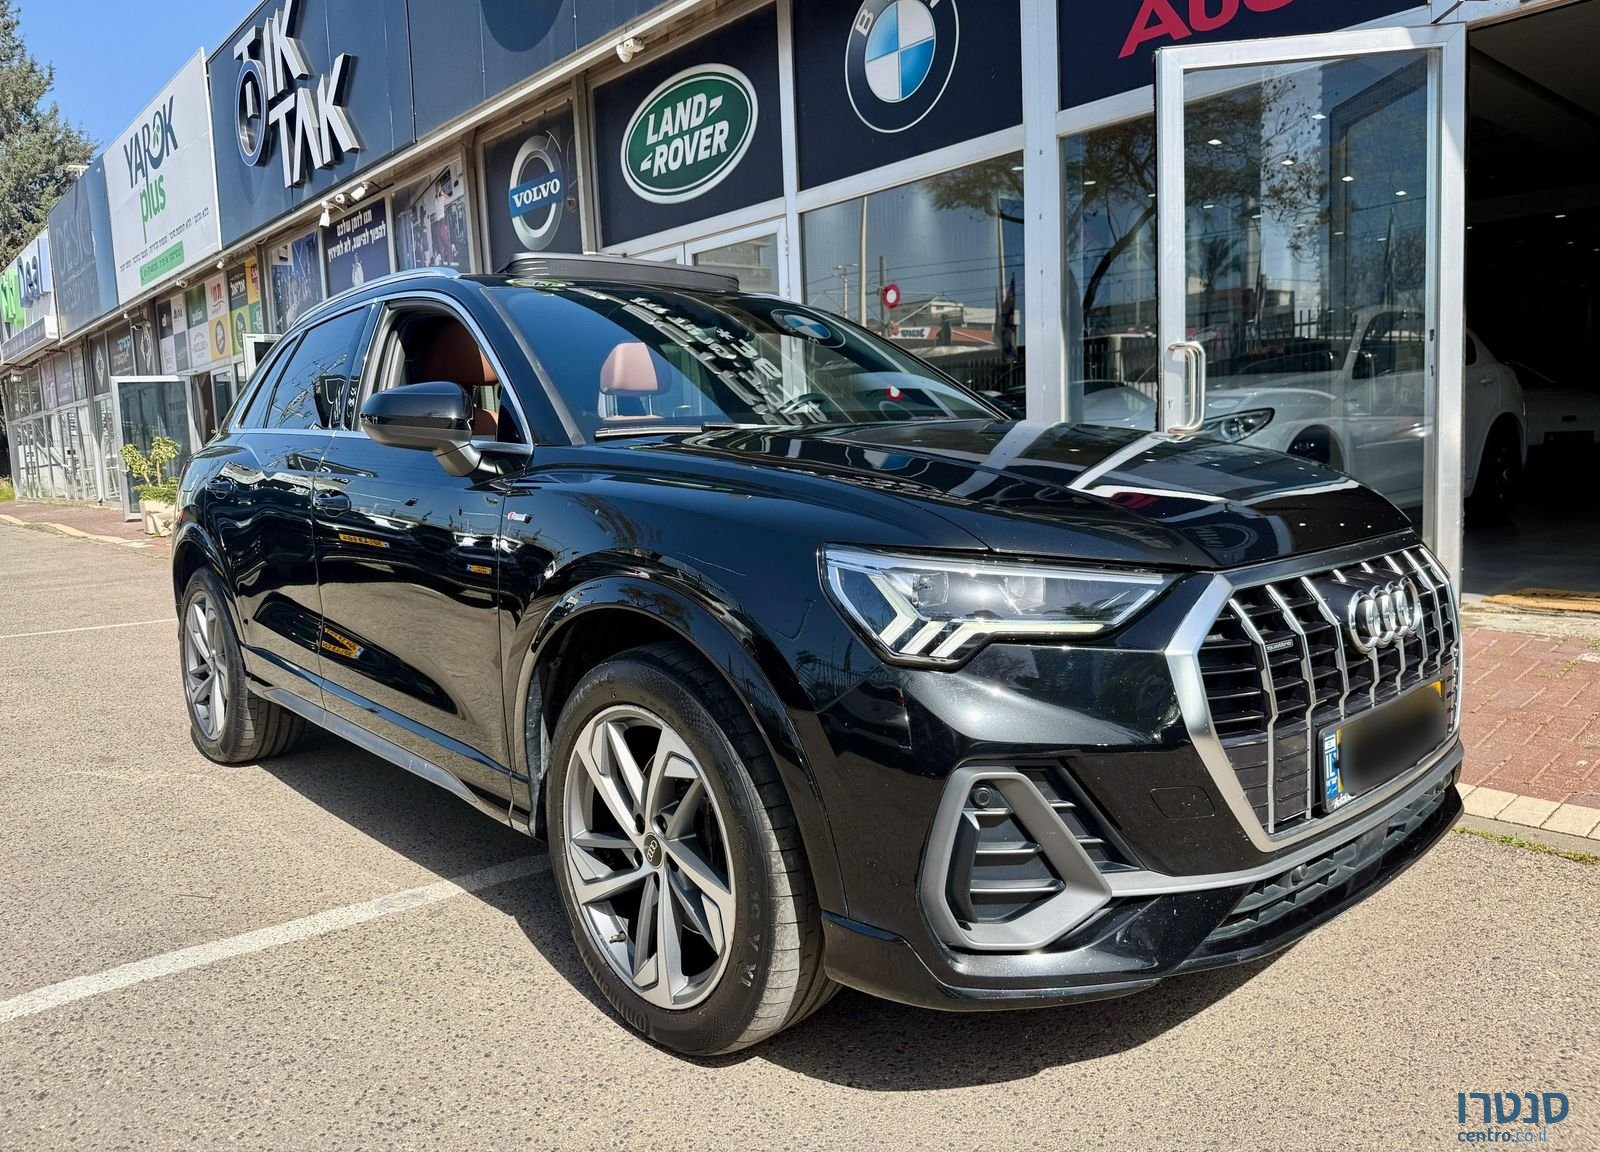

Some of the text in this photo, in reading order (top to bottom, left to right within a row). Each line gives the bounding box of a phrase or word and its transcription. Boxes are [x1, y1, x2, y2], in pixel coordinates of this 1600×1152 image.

[123, 95, 178, 188] YAROK
[269, 53, 360, 188] TAK
[646, 92, 707, 146] LAND
[652, 120, 729, 178] ROVER
[139, 174, 166, 243] plus
[512, 178, 561, 208] VOLVO
[344, 236, 351, 254] לא
